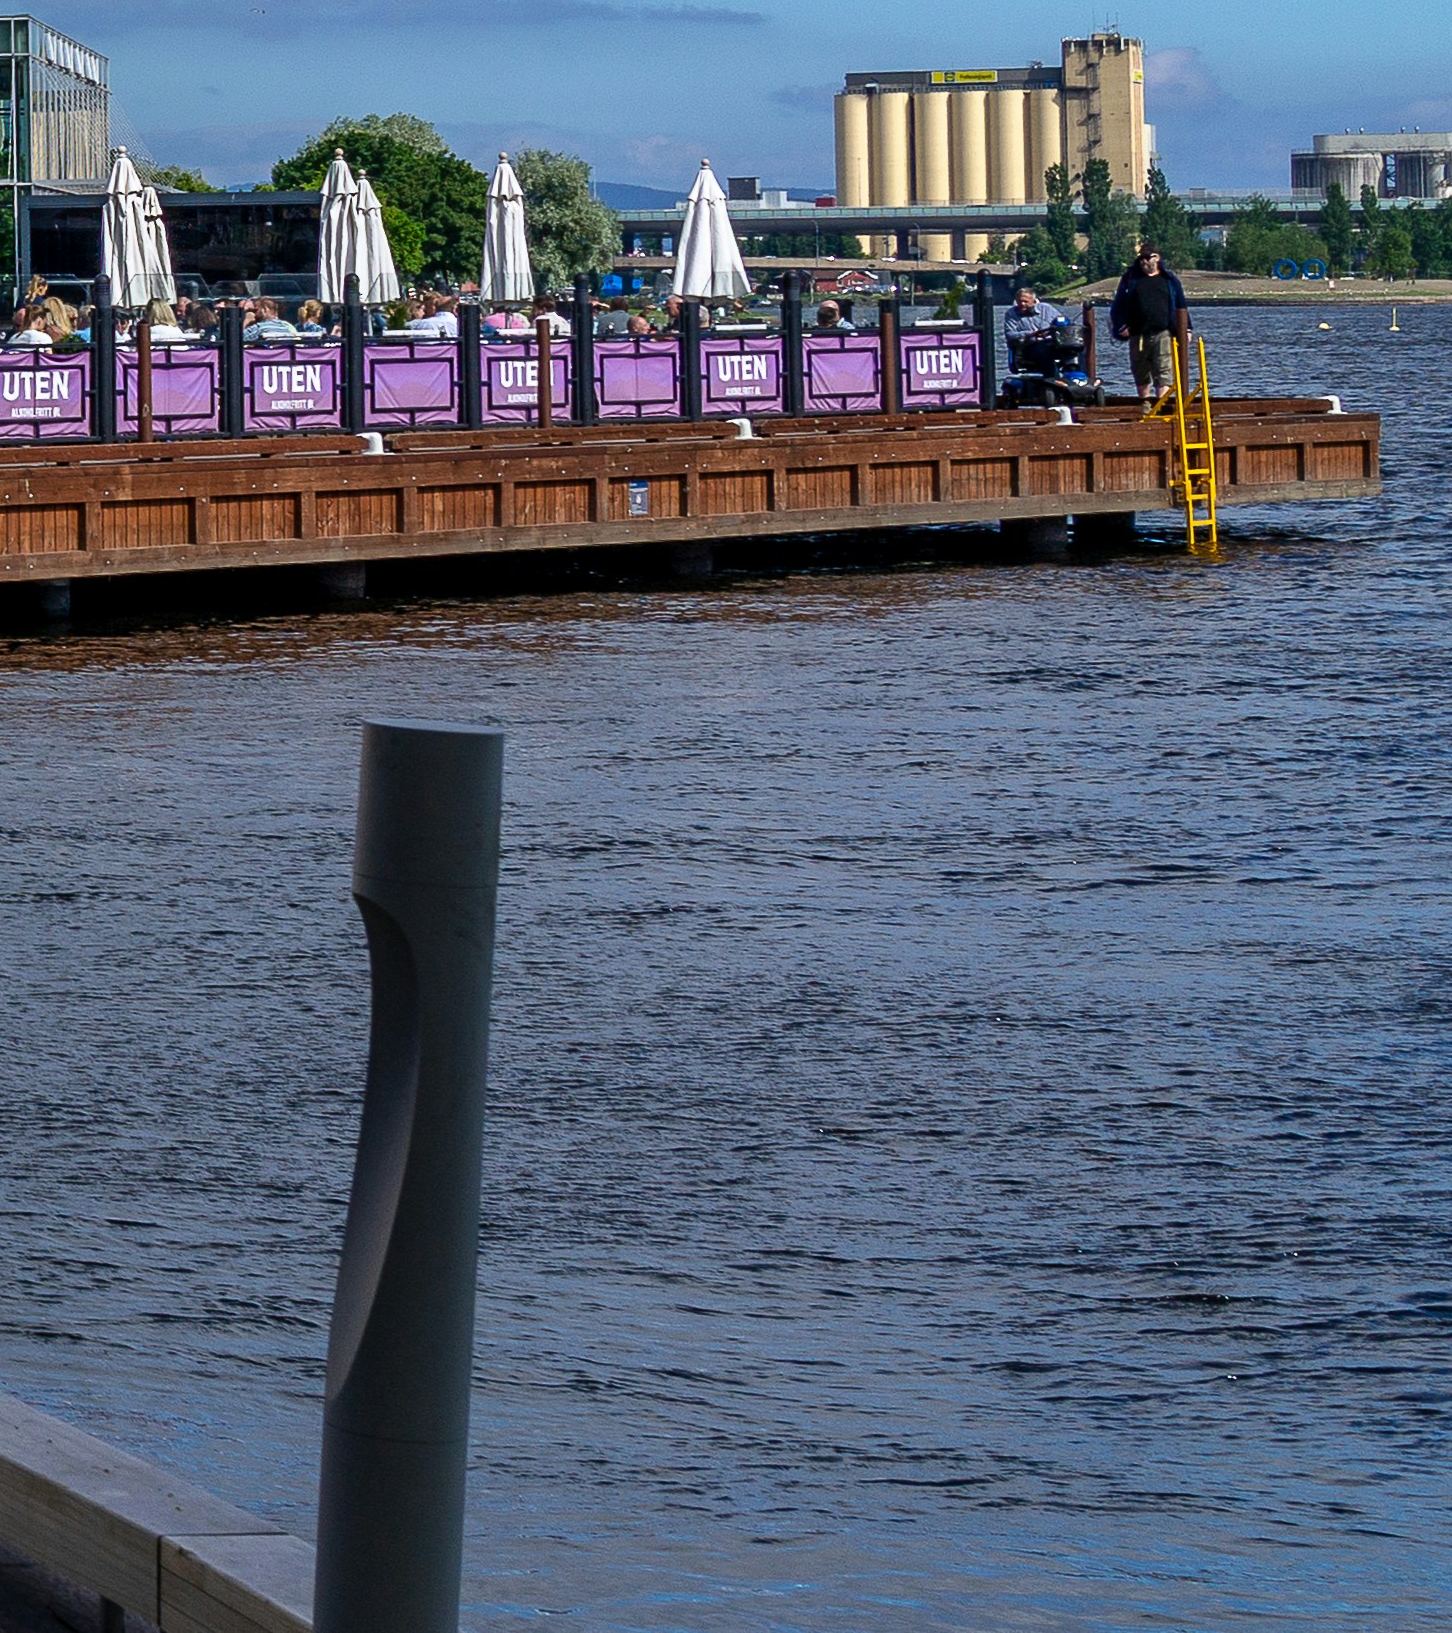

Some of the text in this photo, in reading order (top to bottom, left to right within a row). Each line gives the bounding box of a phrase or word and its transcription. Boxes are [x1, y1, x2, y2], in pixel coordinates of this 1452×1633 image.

[717, 354, 767, 382] UTEN
[915, 349, 963, 375] UTEN
[2, 371, 69, 401] UTEN
[262, 365, 321, 394] UTEN
